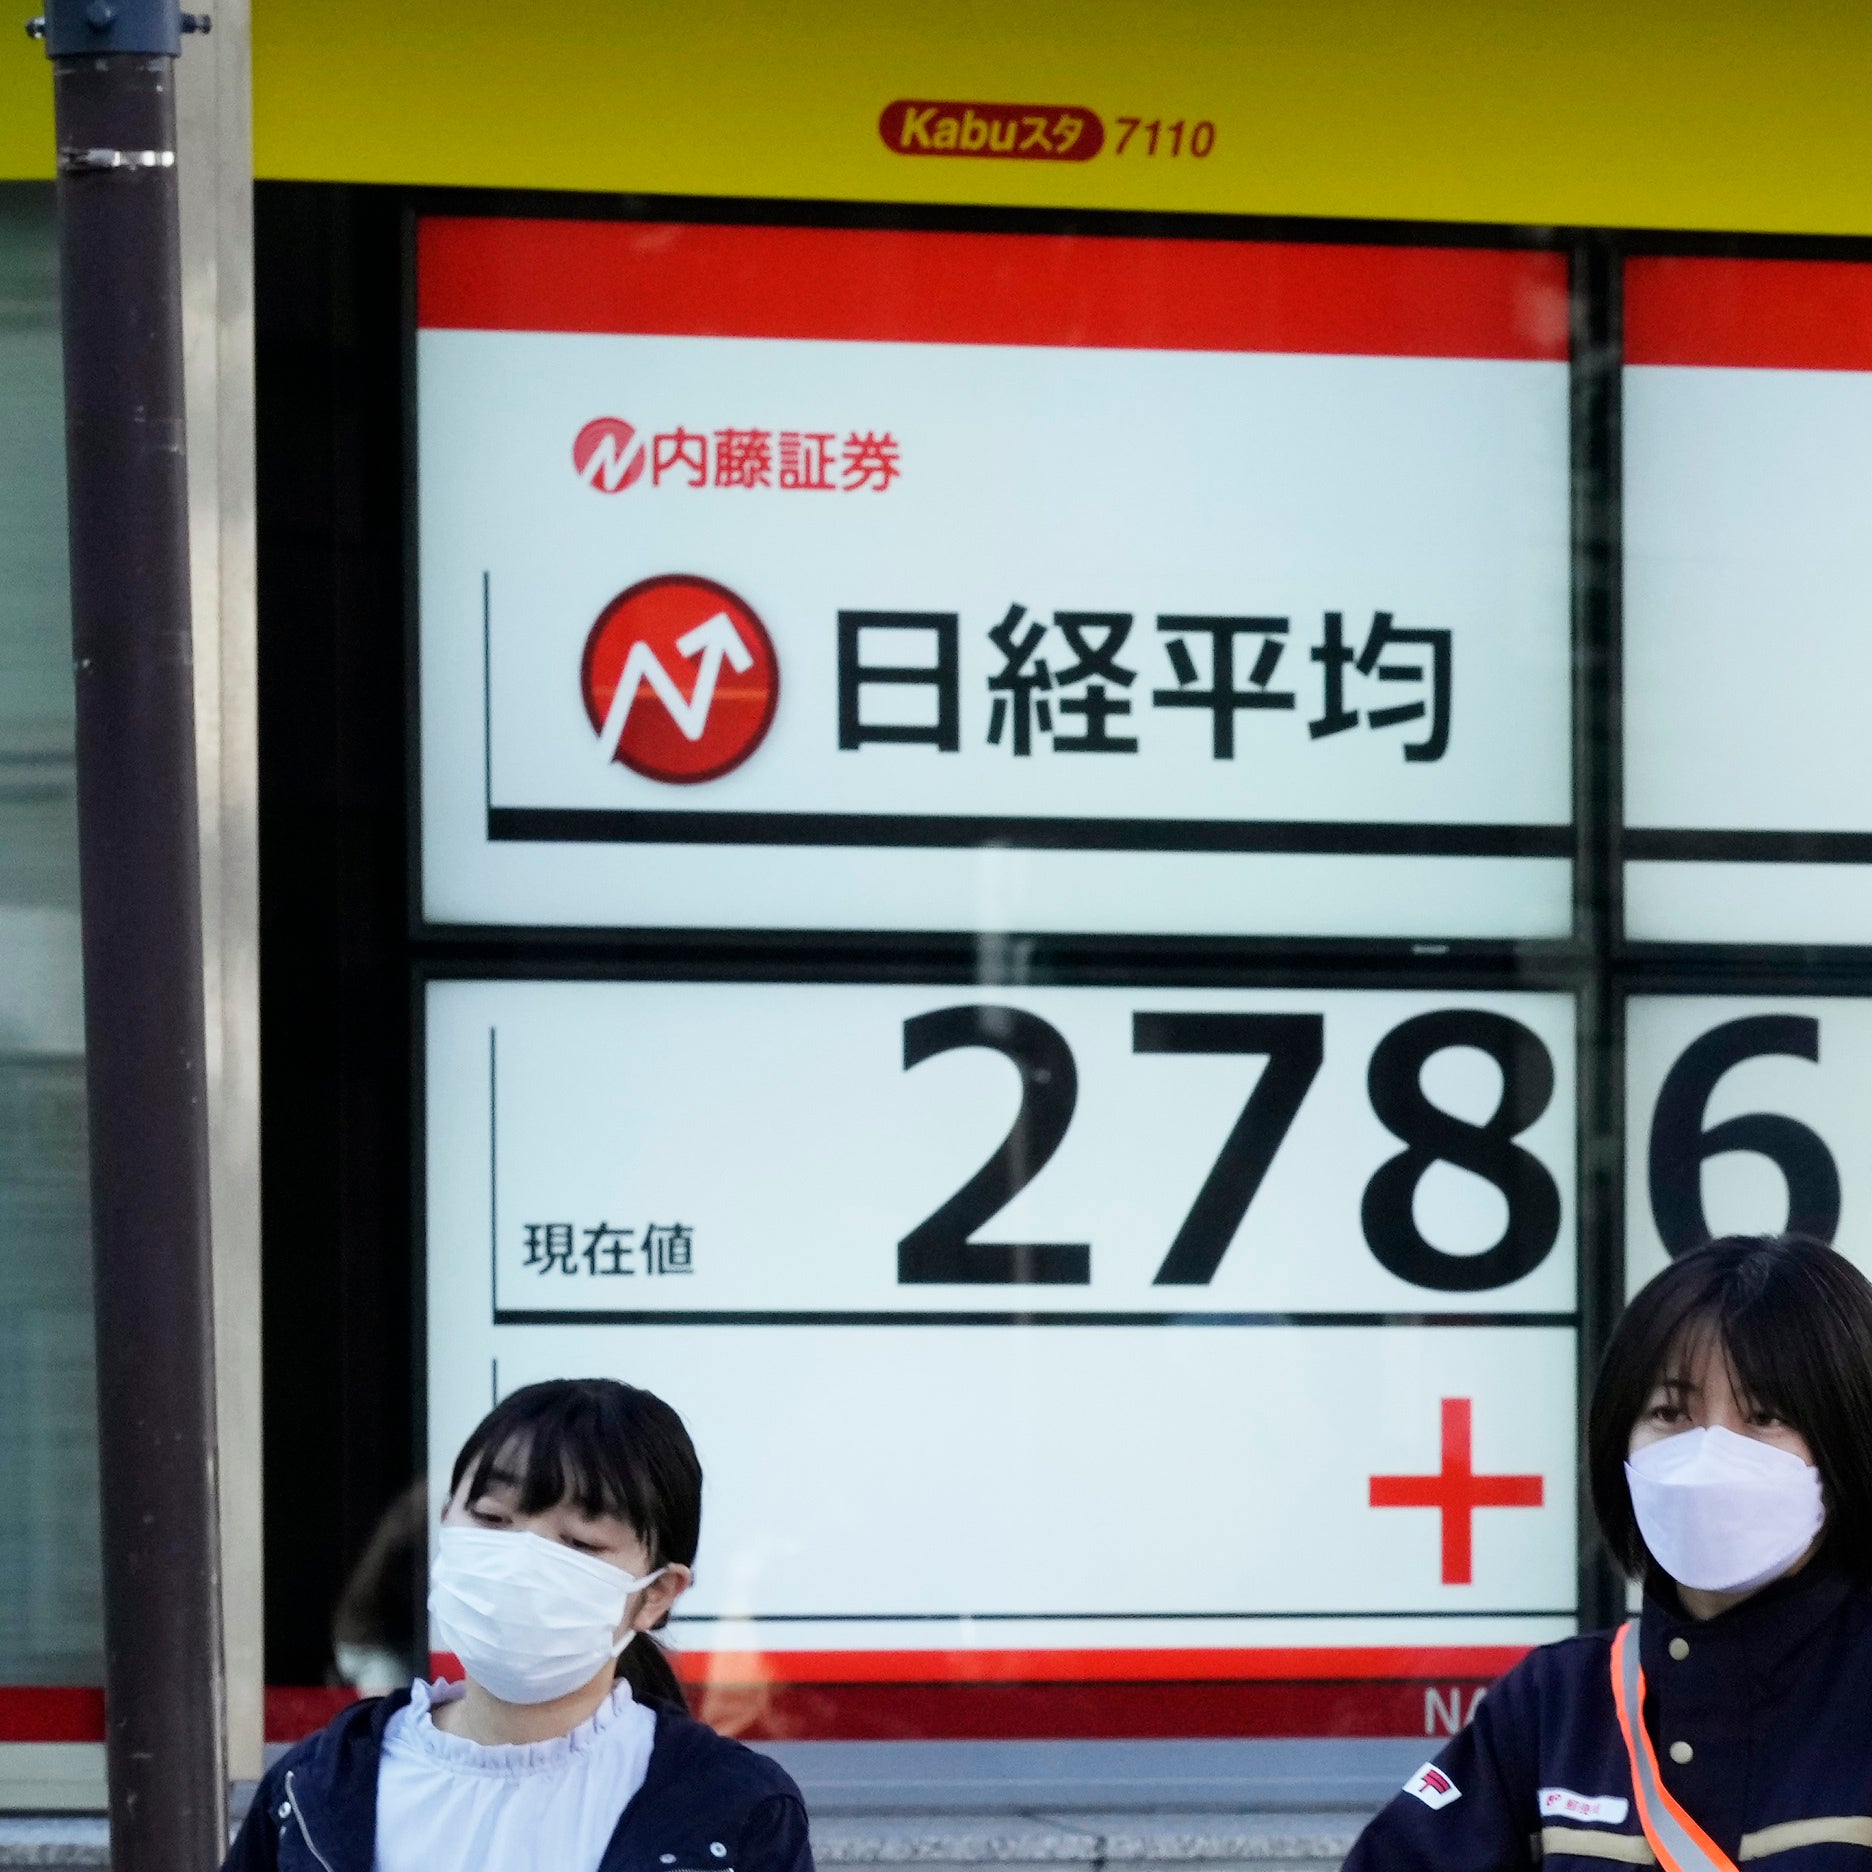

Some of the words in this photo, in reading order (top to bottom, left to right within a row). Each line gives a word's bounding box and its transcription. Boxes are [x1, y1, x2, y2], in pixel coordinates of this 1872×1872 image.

[1114, 117, 1216, 158] 7110
[652, 425, 901, 492] 内藤証券
[834, 602, 1456, 762] 日経平均
[523, 1221, 694, 1276] 現在値
